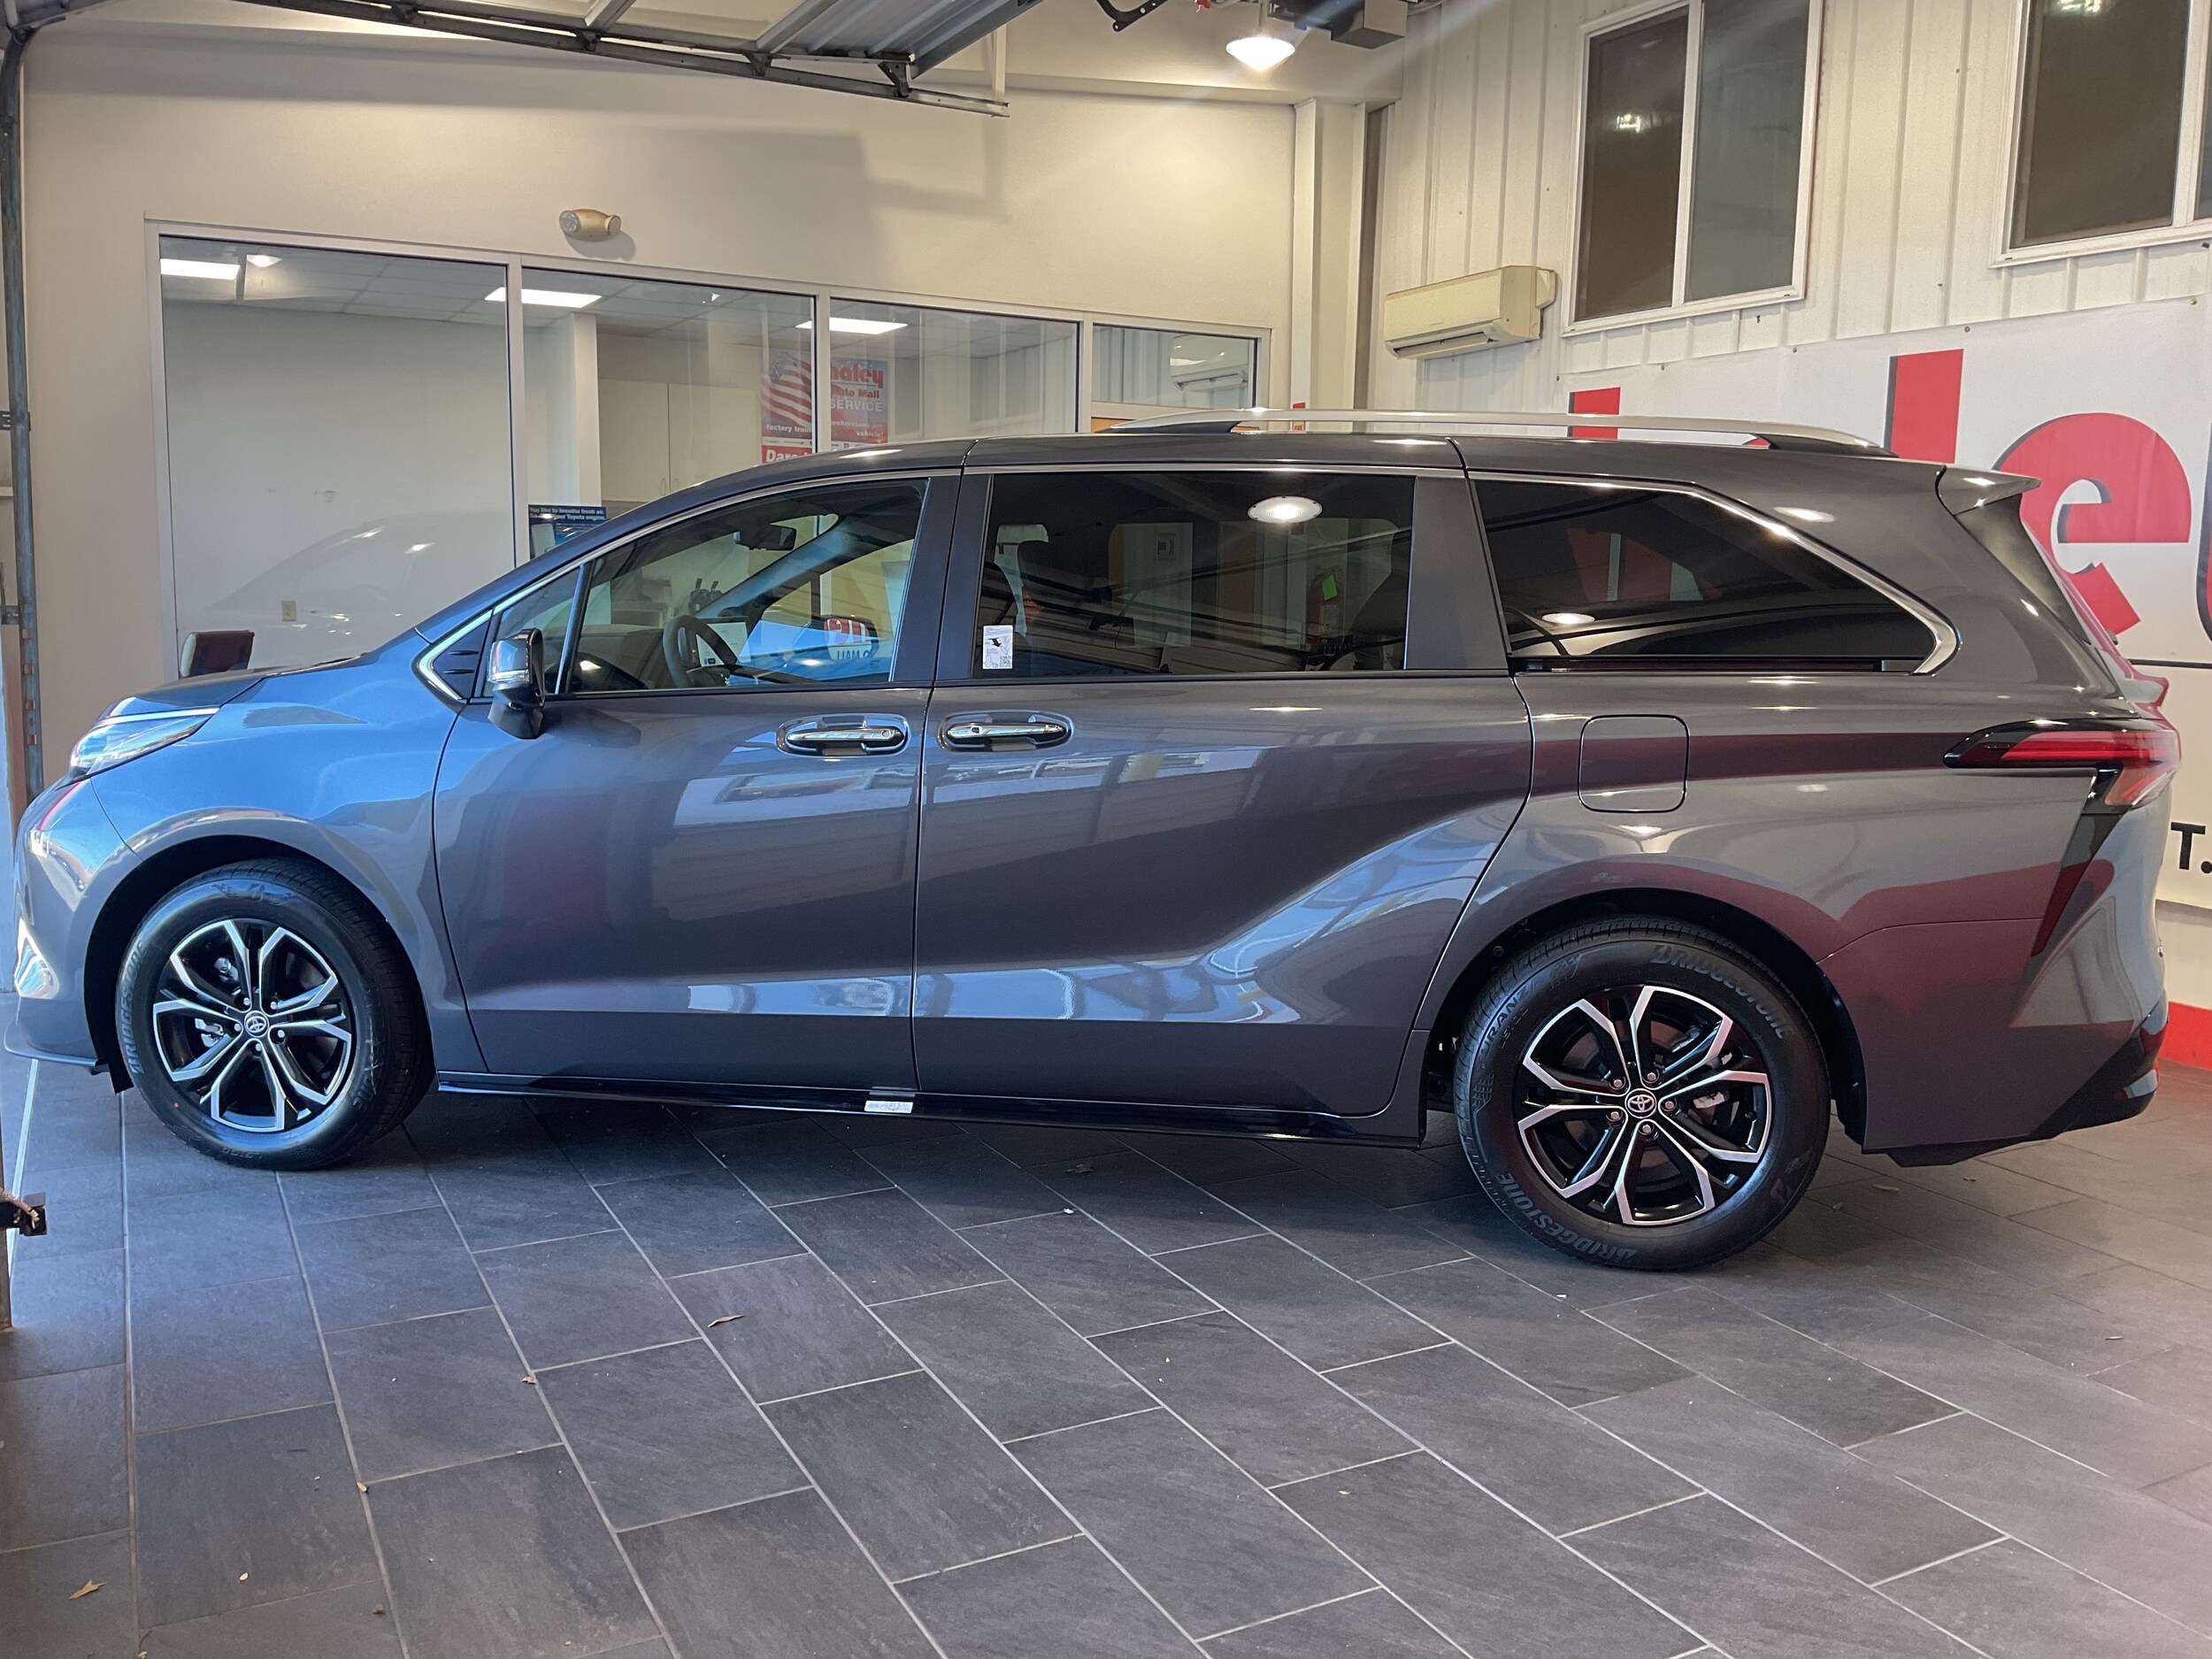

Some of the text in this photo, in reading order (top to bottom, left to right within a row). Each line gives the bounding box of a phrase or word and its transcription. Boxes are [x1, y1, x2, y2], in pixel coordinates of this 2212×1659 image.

[858, 389, 879, 399] Mall
[831, 399, 883, 412] SERVICE
[766, 424, 793, 434] factory
[121, 939, 144, 1075] BRIDGESTONE
[1494, 1170, 1638, 1263] BRIDGESTONE
